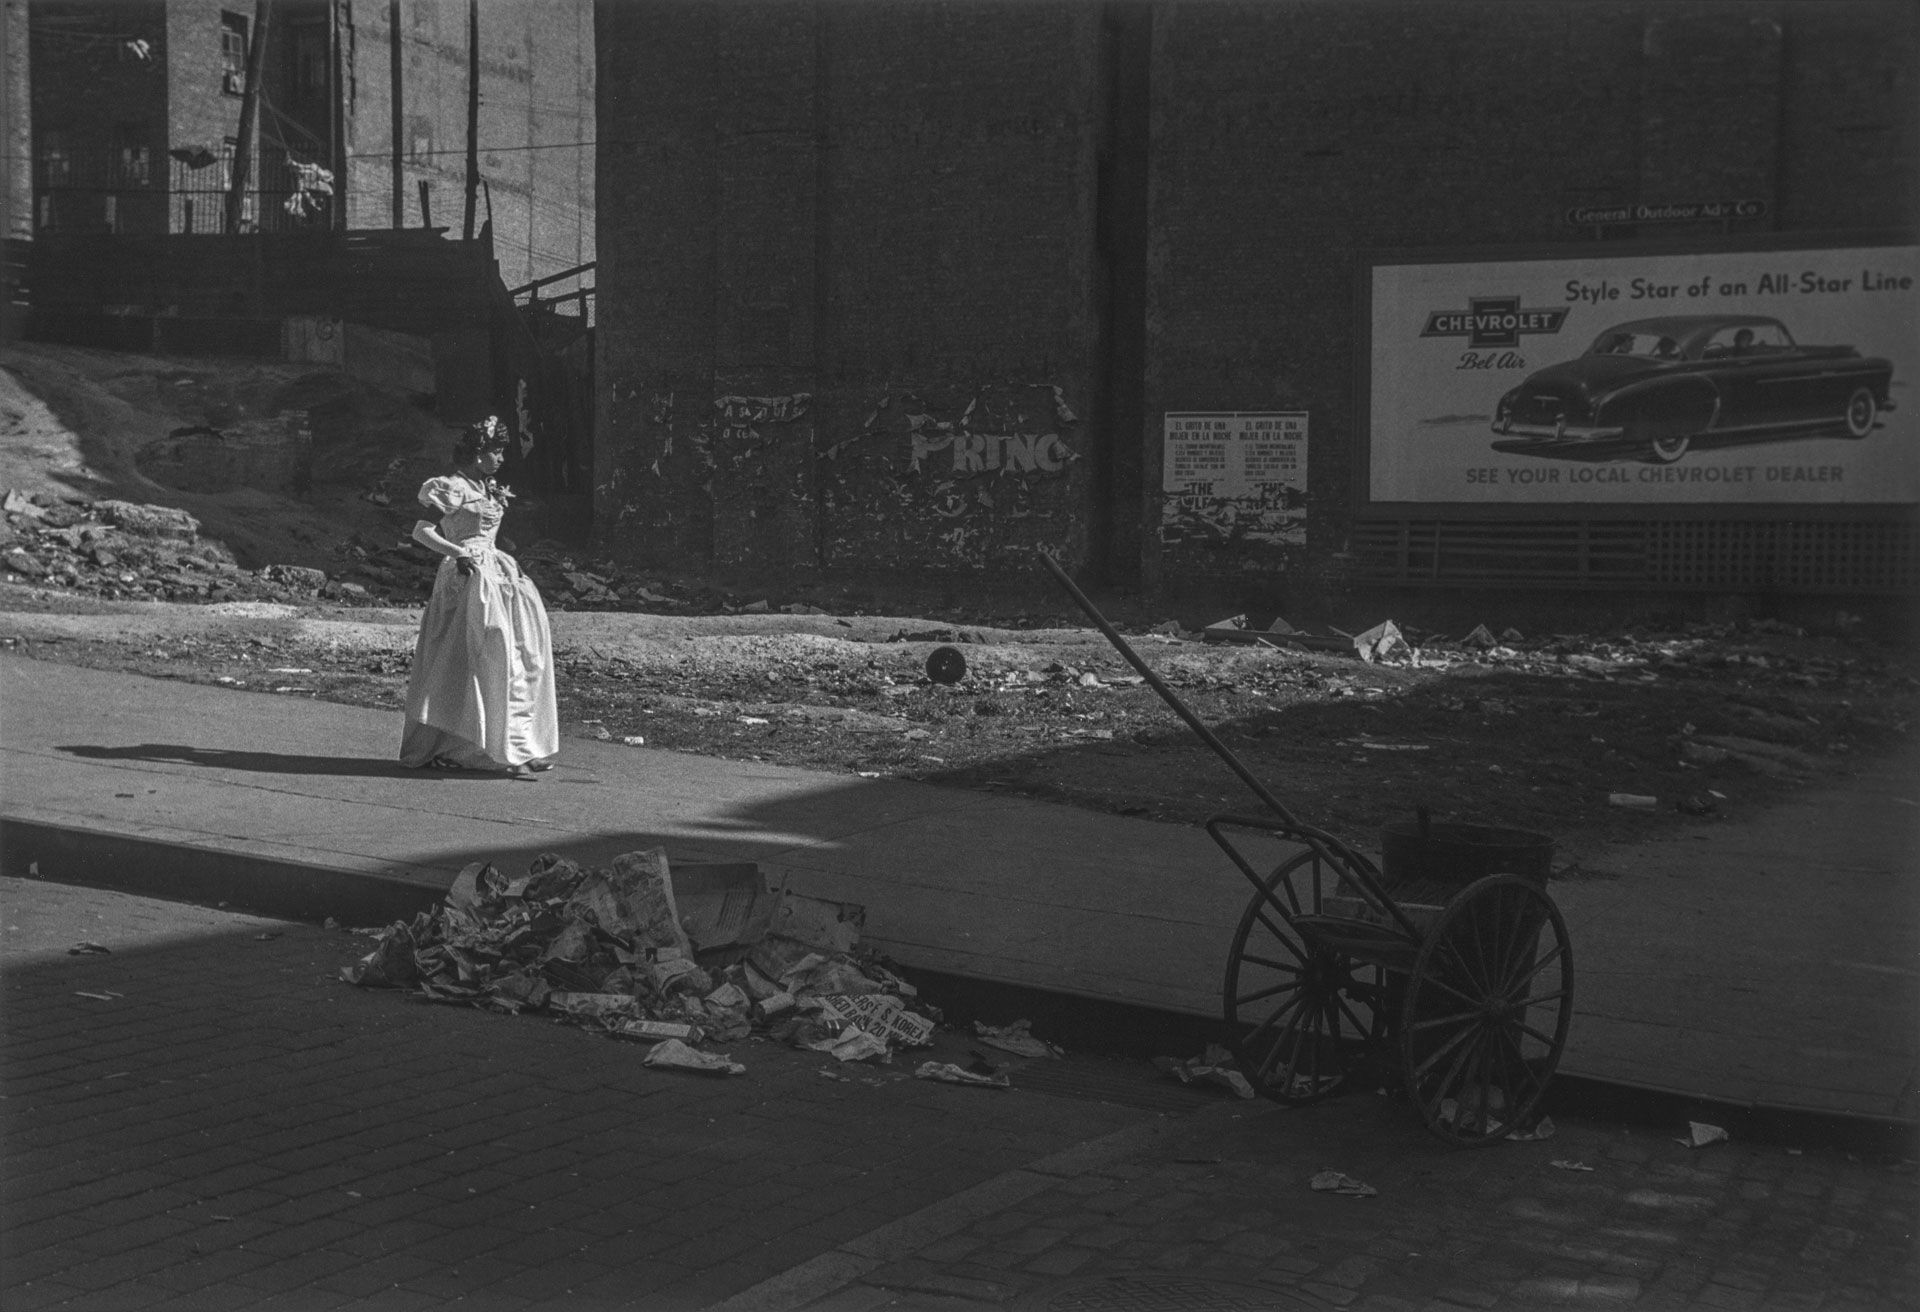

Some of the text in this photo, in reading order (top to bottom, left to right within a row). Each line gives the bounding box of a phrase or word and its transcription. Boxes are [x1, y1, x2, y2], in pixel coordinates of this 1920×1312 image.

[1575, 204, 1632, 222] General
[1636, 201, 1697, 219] Outdoor
[1565, 269, 1914, 306] Style Star of an All-Star Line
[1435, 313, 1554, 332] CHEVROLET
[1456, 351, 1526, 371] Bel Air
[1465, 465, 1844, 484] SEE YOUR LOCAL CHEVROLET DEALER
[868, 1021, 887, 1038] 20
[891, 1014, 925, 1040] KOREA
